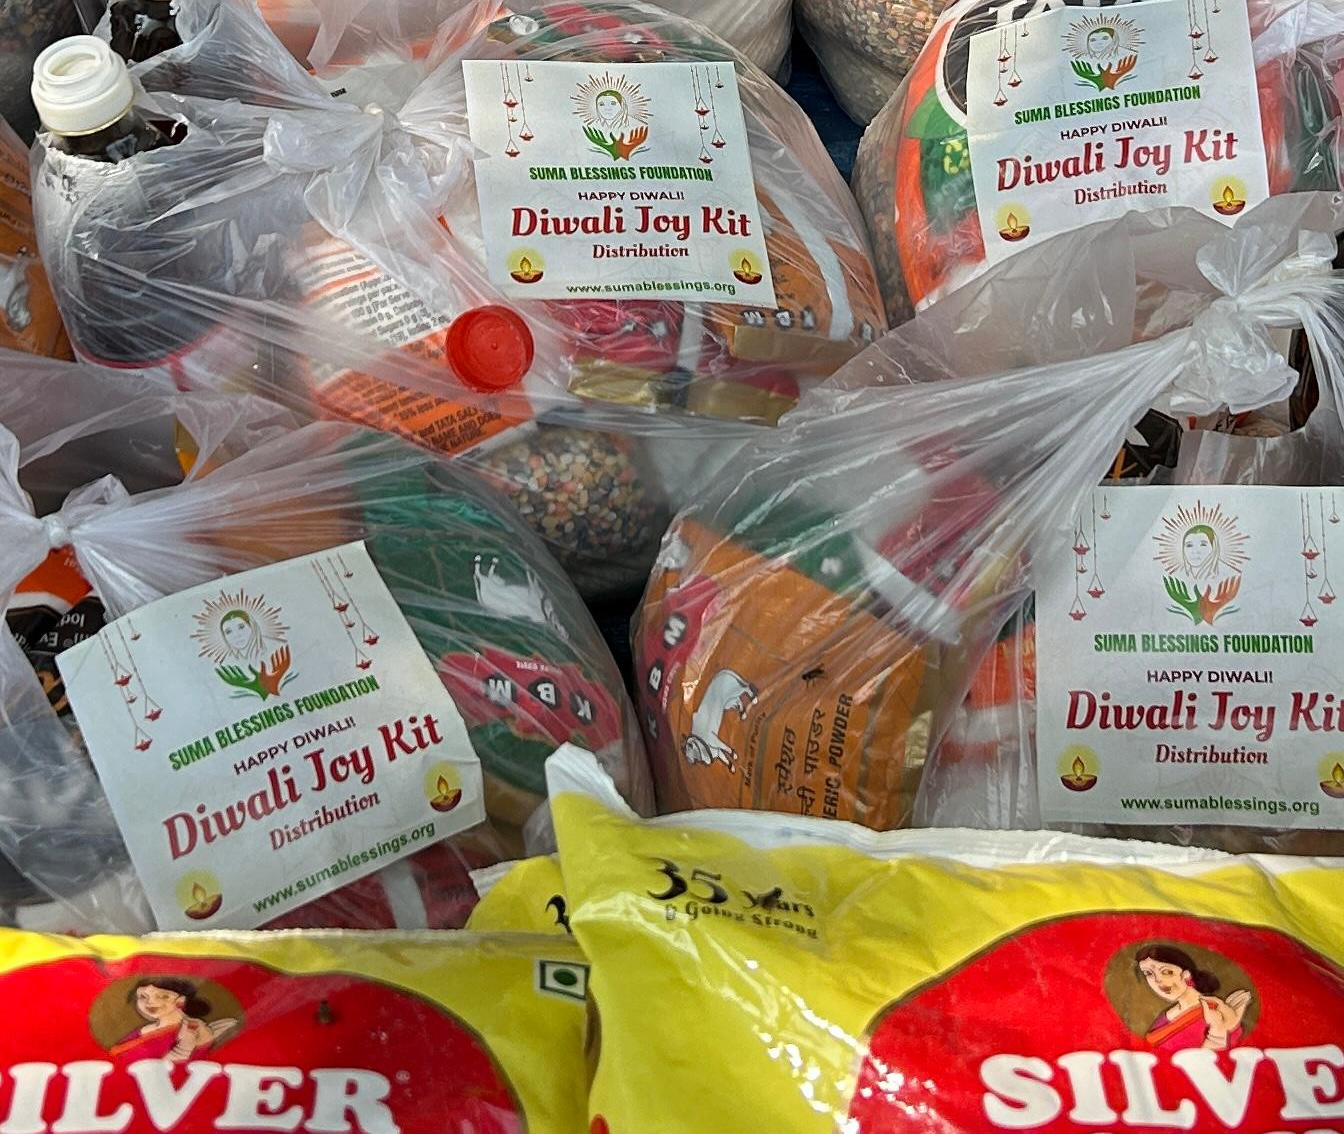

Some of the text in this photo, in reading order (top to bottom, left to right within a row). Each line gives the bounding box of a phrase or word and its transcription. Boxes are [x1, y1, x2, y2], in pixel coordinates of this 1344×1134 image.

[1015, 85, 1201, 125] SUMA BLESSINGS FOUNDATION
[1060, 116, 1167, 140] HAPPY DIWALI!
[529, 167, 713, 181] SUMA BLESSINGS FOUNDATION
[996, 129, 1238, 191] Diwali Joy Kit
[578, 192, 684, 201] HAPPY DIWALI!
[1074, 179, 1168, 204] Distribution
[511, 205, 751, 241] Diwali Joy Kit
[593, 243, 689, 258] Distribution
[566, 280, 737, 295] www.sumablessings.org
[1094, 634, 1313, 653] SUMA BLESSINGS FOUNDATION
[1147, 671, 1273, 683] HAPPY DIWALI!
[168, 674, 380, 771] SUMA BLESSINGS FOUNDATION
[827, 692, 854, 766] POWDER
[1066, 690, 1197, 730] Diwali
[1208, 691, 1275, 742] Joy
[233, 715, 356, 774] HAPPY DIWALI!
[1156, 744, 1268, 764] Distribution
[162, 714, 443, 863] Diwali Joy Kit
[1121, 795, 1320, 816] www.sumablessings.org
[269, 792, 381, 850] Distribution
[250, 821, 437, 913] www.sumablessings.org
[646, 857, 729, 904] 35
